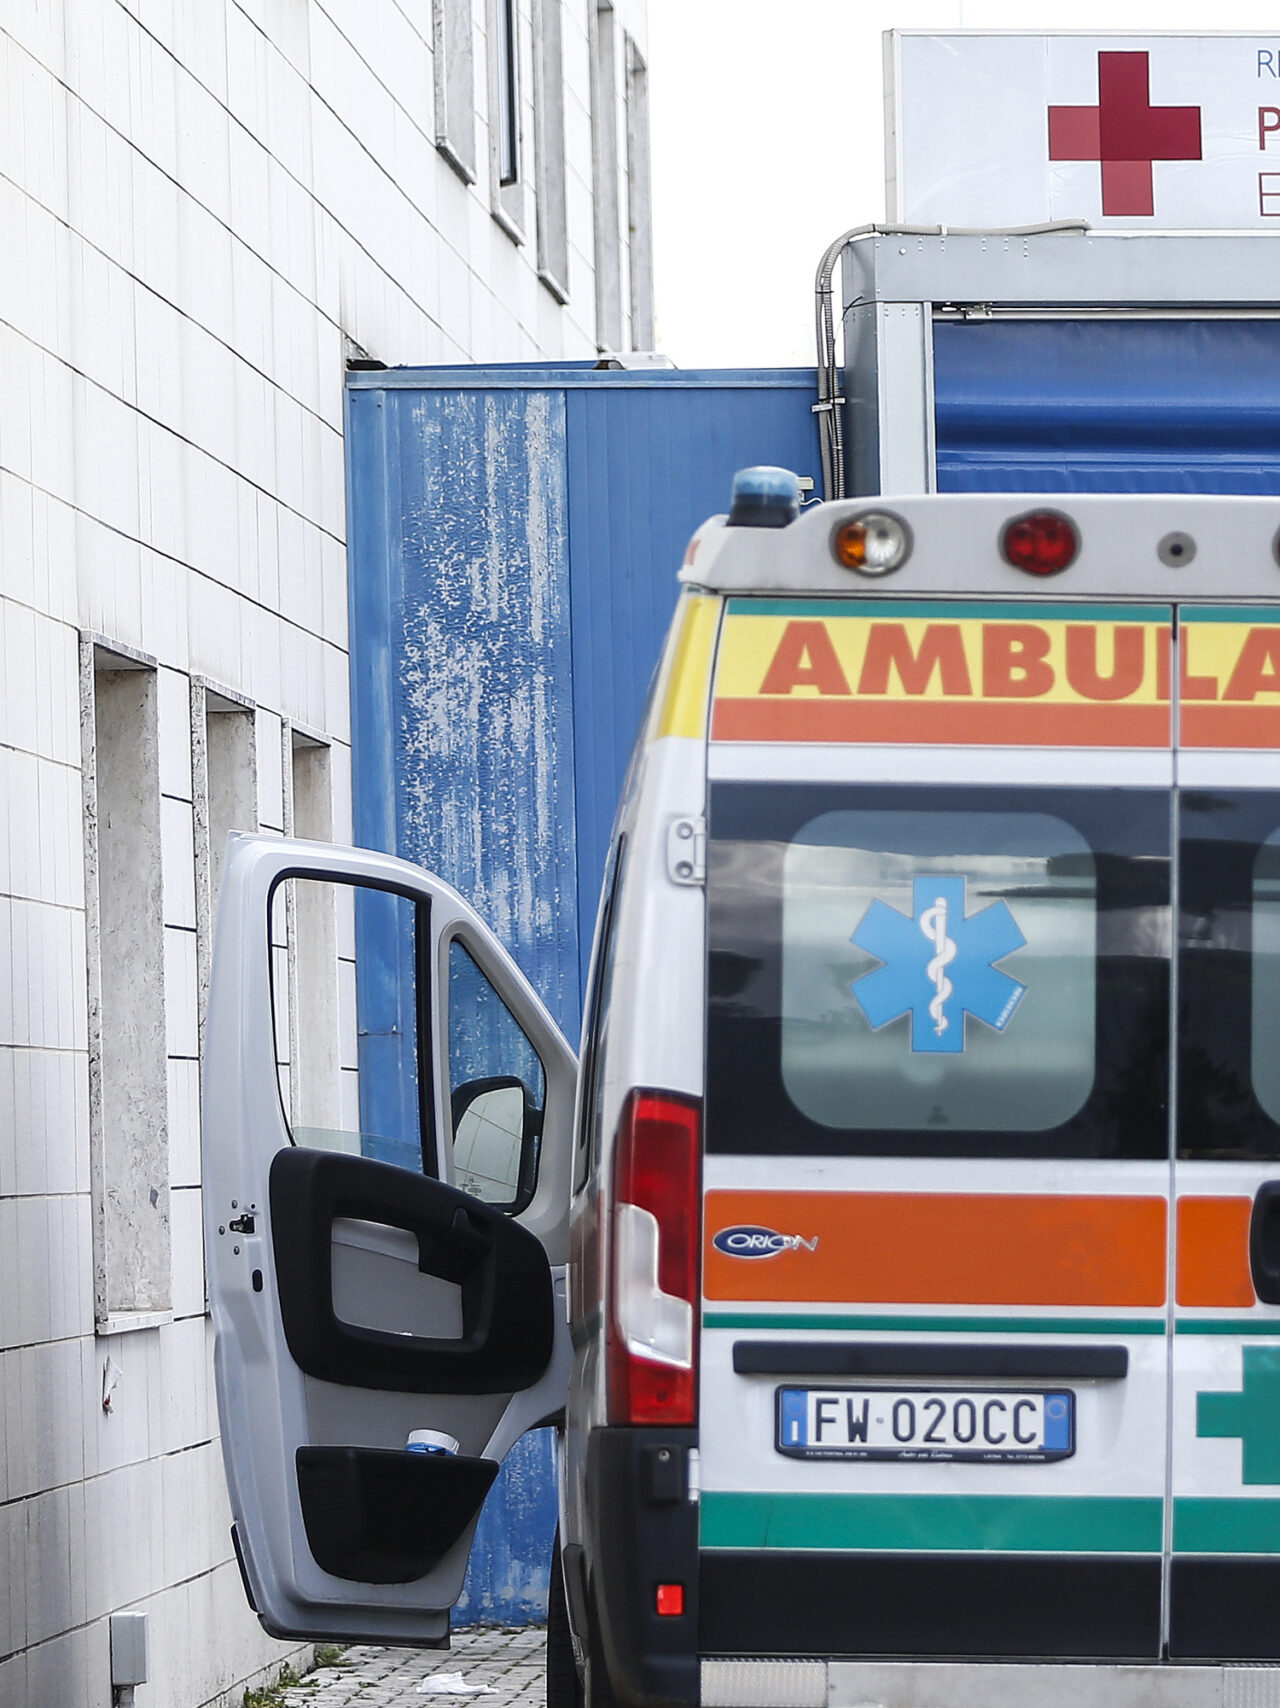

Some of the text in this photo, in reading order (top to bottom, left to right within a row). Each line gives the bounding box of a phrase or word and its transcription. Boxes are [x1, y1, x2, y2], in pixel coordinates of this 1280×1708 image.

[727, 1232, 819, 1251] ORION
[815, 1397, 1038, 1444] FW 020CC
